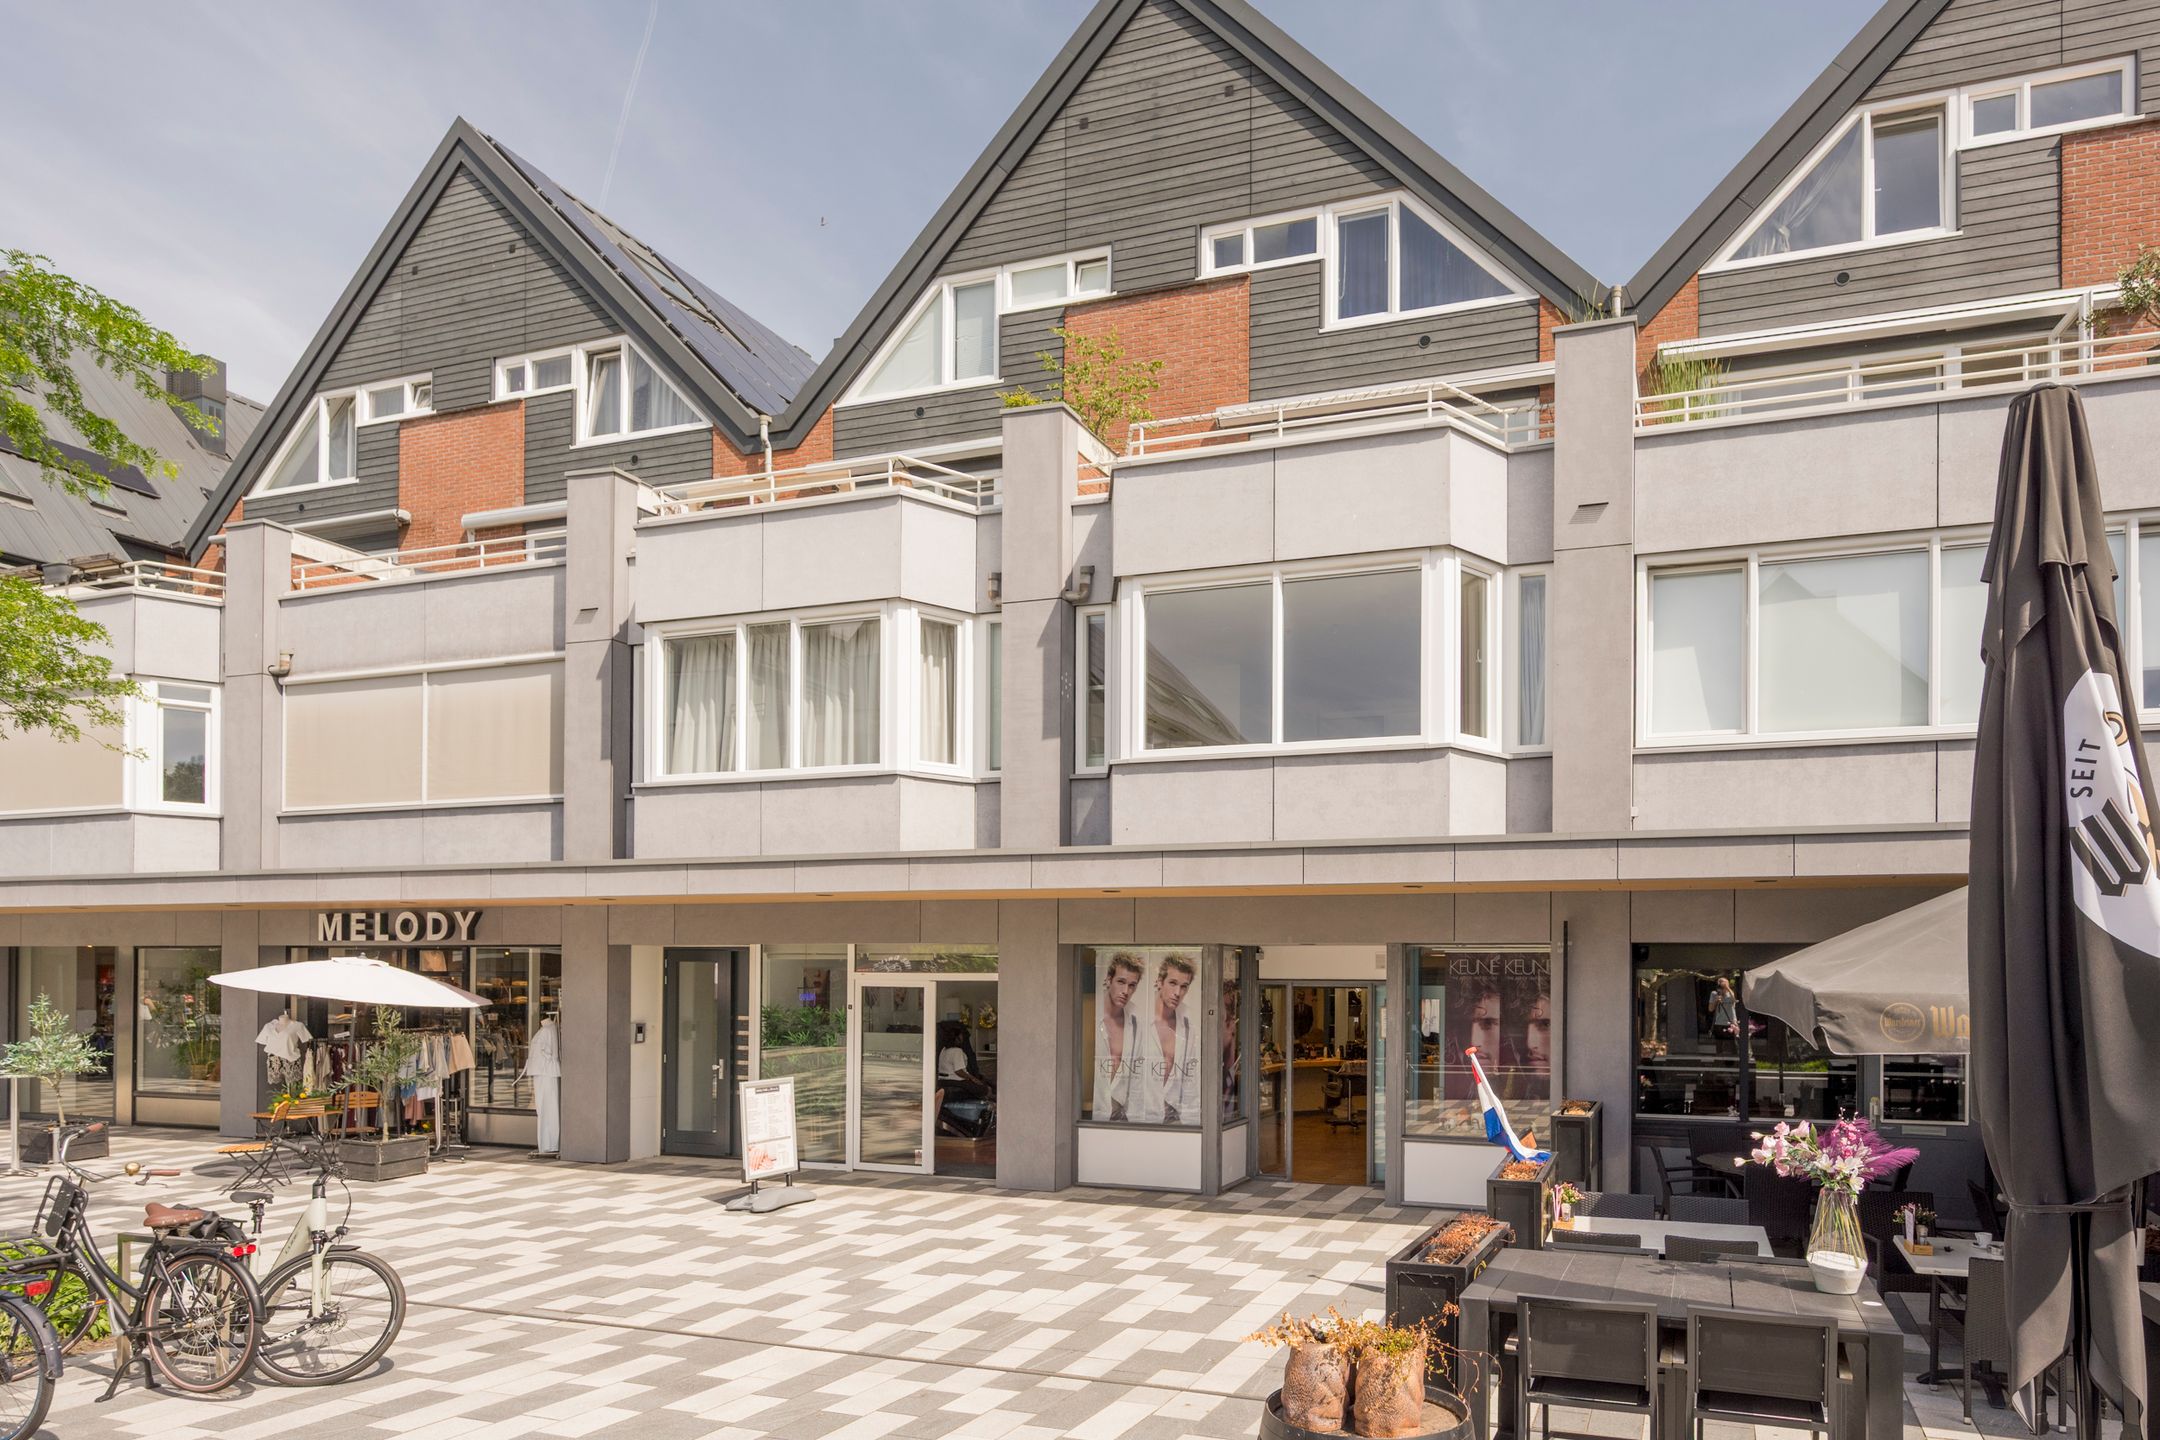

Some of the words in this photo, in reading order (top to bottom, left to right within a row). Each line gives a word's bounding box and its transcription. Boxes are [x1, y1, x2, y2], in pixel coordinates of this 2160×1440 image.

[2070, 738, 2101, 798] SEIT
[317, 911, 482, 943] MELODY
[1449, 957, 1500, 976] KEUNE
[75, 1259, 91, 1280] POPAL
